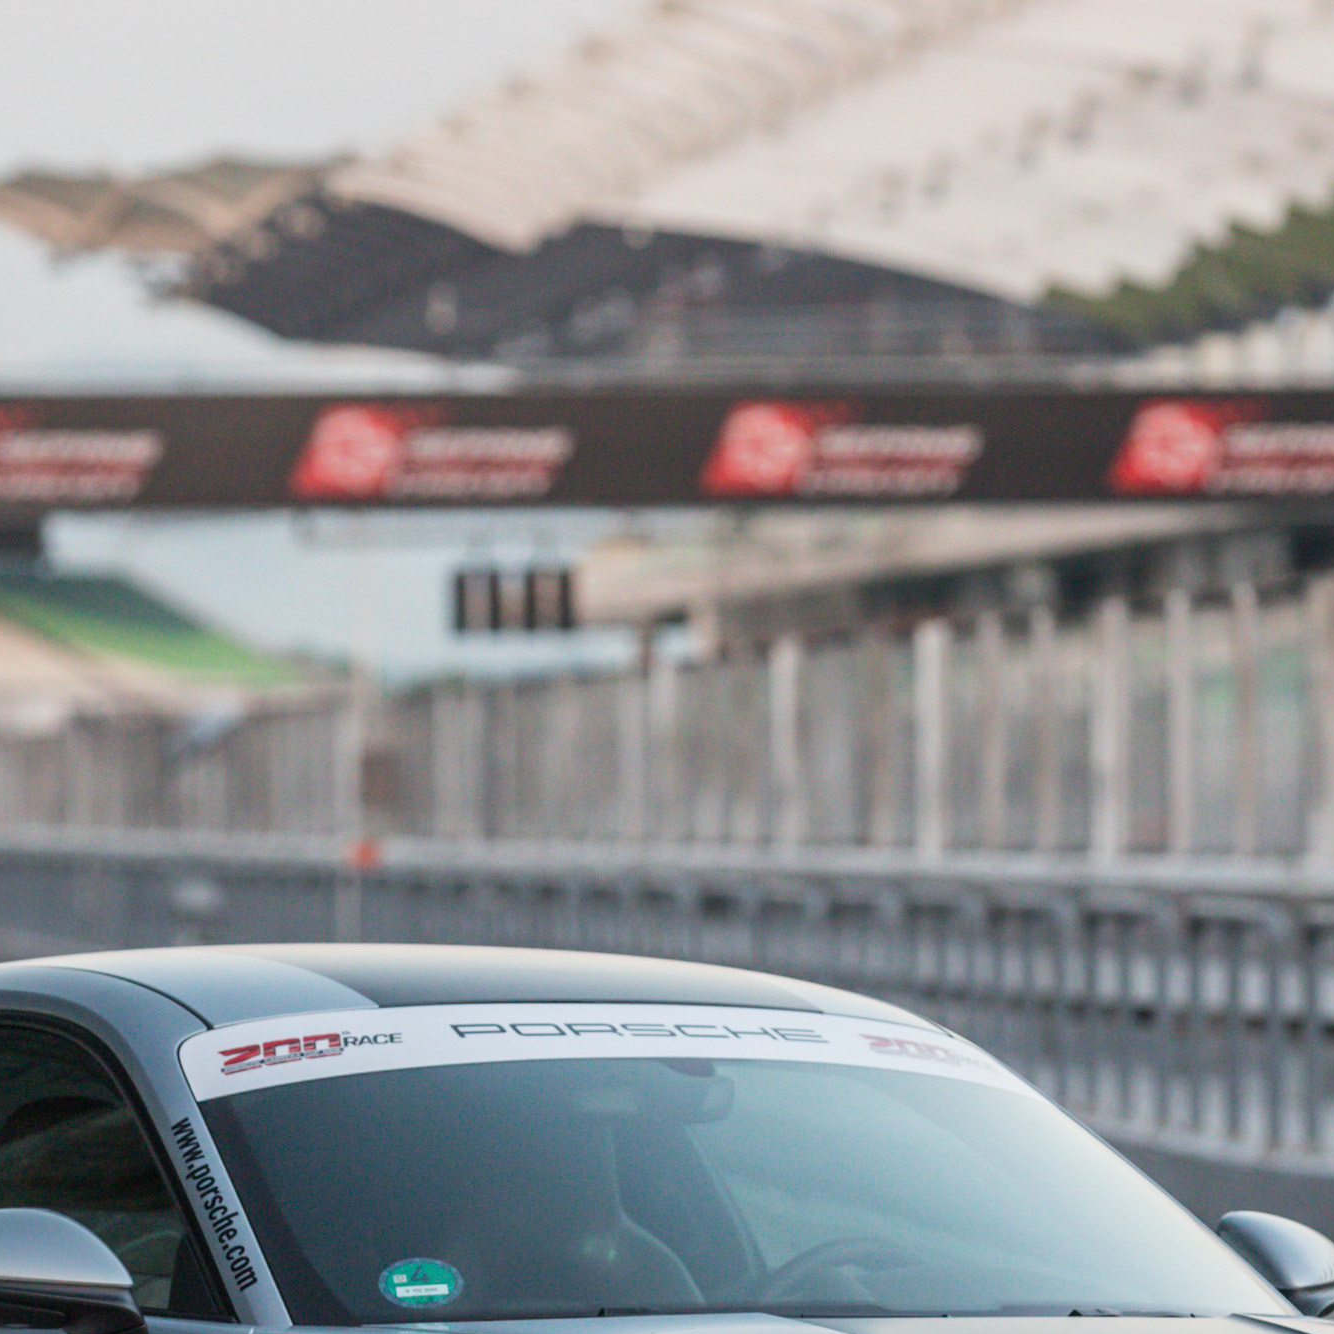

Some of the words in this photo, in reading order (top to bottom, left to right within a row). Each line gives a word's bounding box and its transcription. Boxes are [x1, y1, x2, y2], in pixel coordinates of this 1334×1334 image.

[343, 1032, 403, 1047] RACE
[449, 1023, 829, 1043] PORSCHE
[171, 1117, 258, 1292] www.porsche.com
